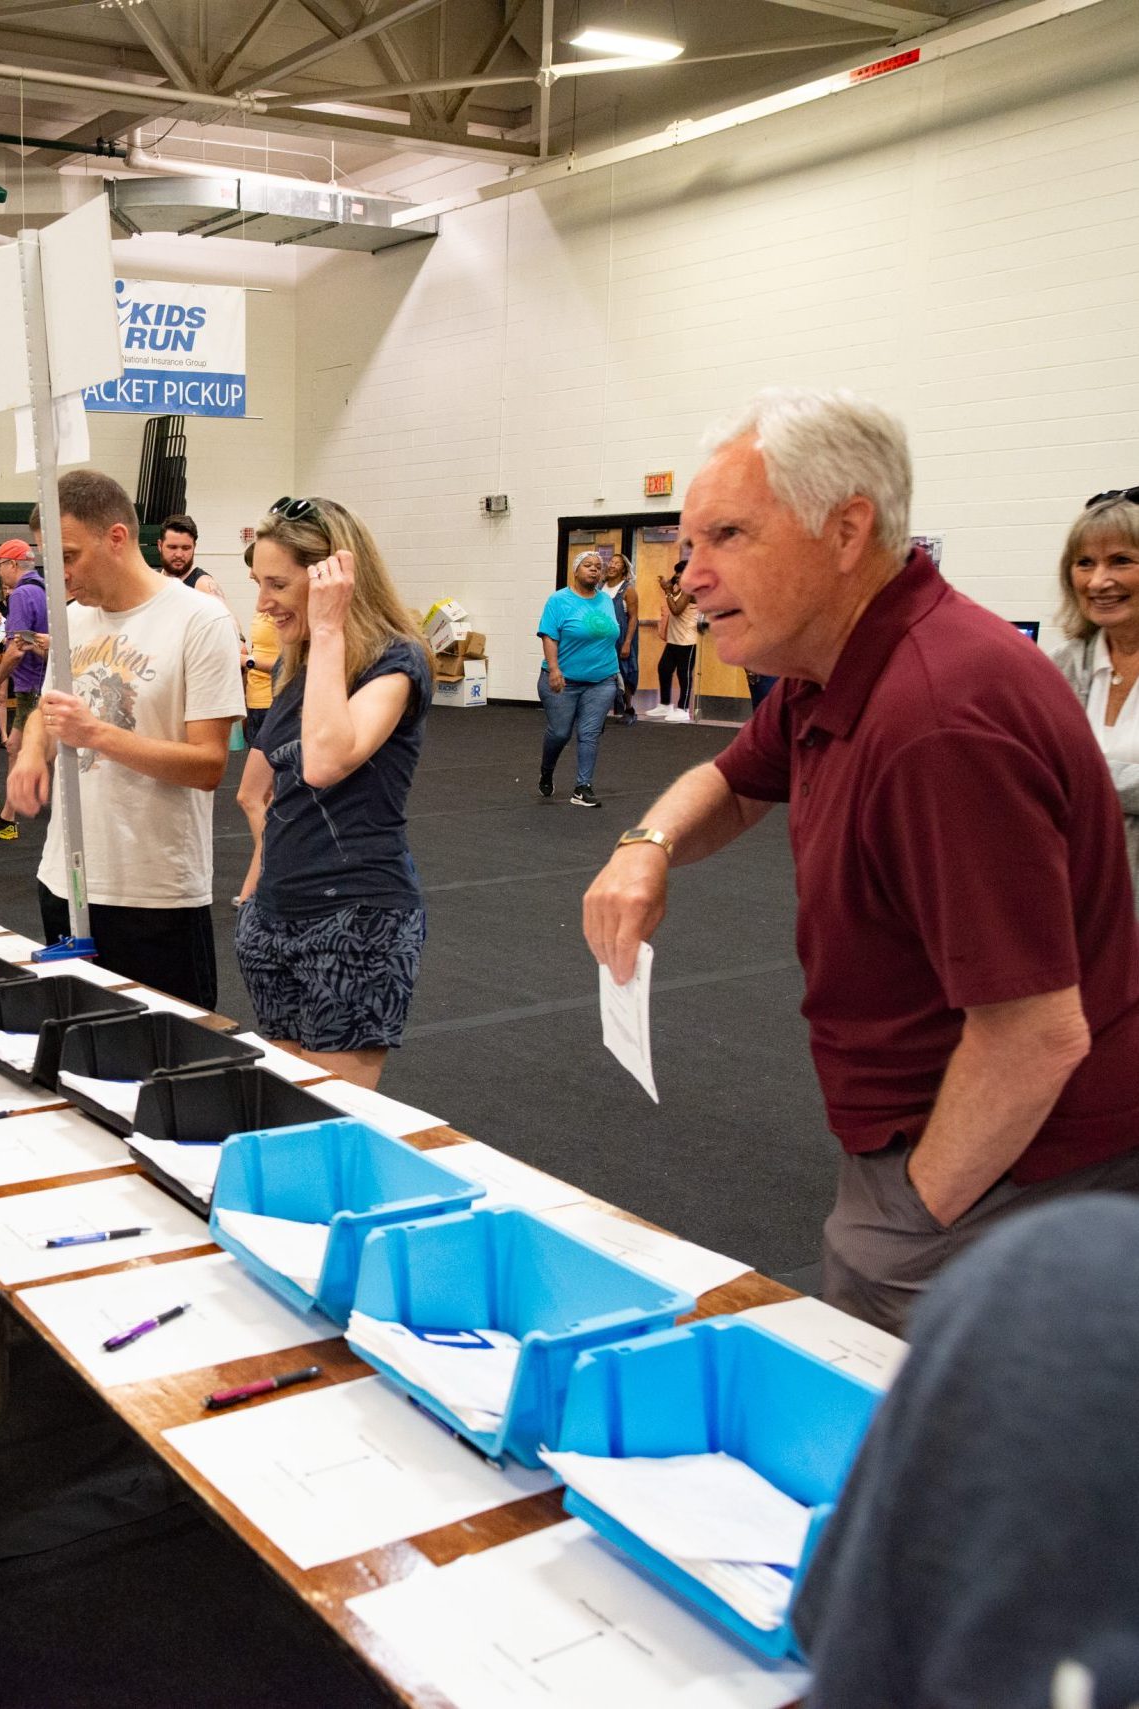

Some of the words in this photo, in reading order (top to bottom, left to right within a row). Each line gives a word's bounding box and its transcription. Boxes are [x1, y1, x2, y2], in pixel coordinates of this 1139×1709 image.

[129, 303, 207, 329] KIDS
[124, 327, 196, 352] RUN
[123, 355, 150, 364] National
[151, 357, 184, 366] Insurance
[186, 358, 207, 367] Group
[83, 379, 159, 404] ACKET
[164, 381, 243, 407] PICKUP
[648, 475, 666, 494] EXIT
